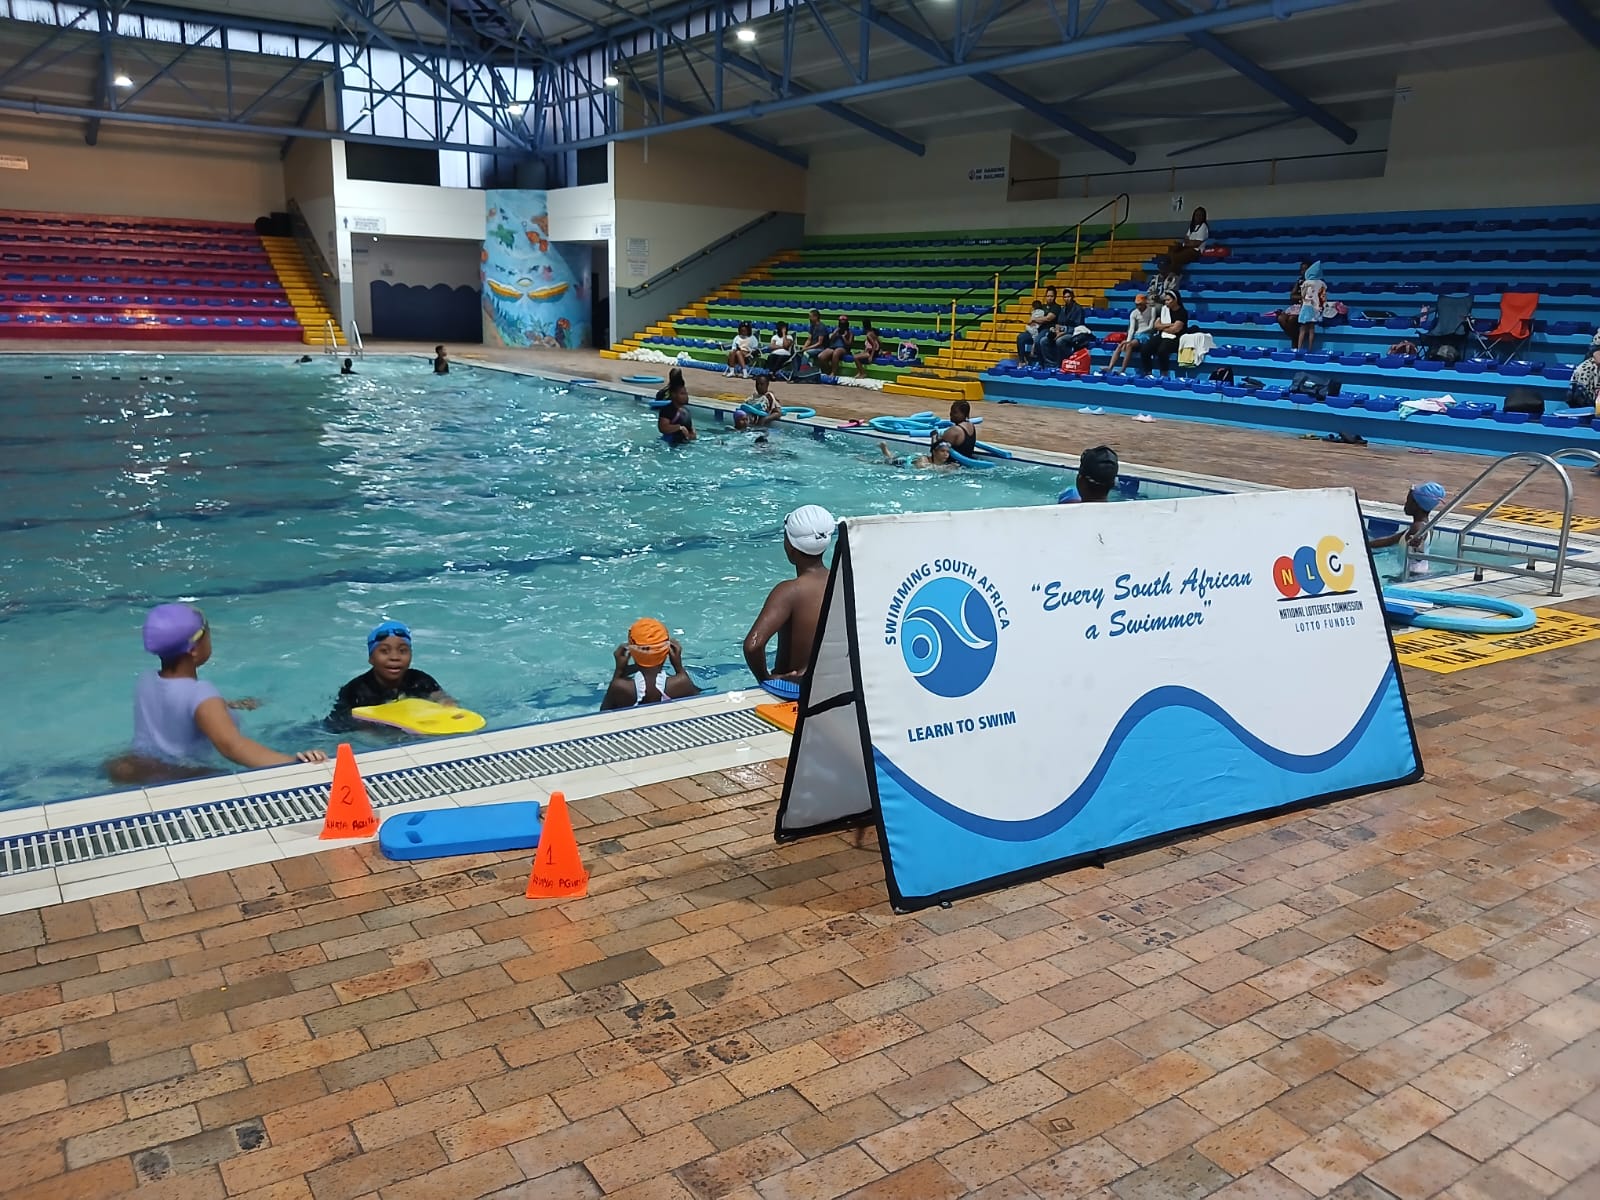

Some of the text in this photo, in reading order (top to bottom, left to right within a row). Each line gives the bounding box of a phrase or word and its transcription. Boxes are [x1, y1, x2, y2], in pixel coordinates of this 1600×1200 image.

[885, 559, 1010, 645] SWIMMING SOUTH AFRICA
[1031, 567, 1252, 611] “Every South African
[1085, 600, 1212, 640] a Swimmer”
[1279, 600, 1364, 620] NATIONAL LOTTERIES COMMISSION
[1295, 616, 1356, 633] LOTTO FUNDED
[908, 711, 1017, 743] LEARN TO SWIM
[340, 785, 354, 806] 2
[545, 844, 557, 866] 1
